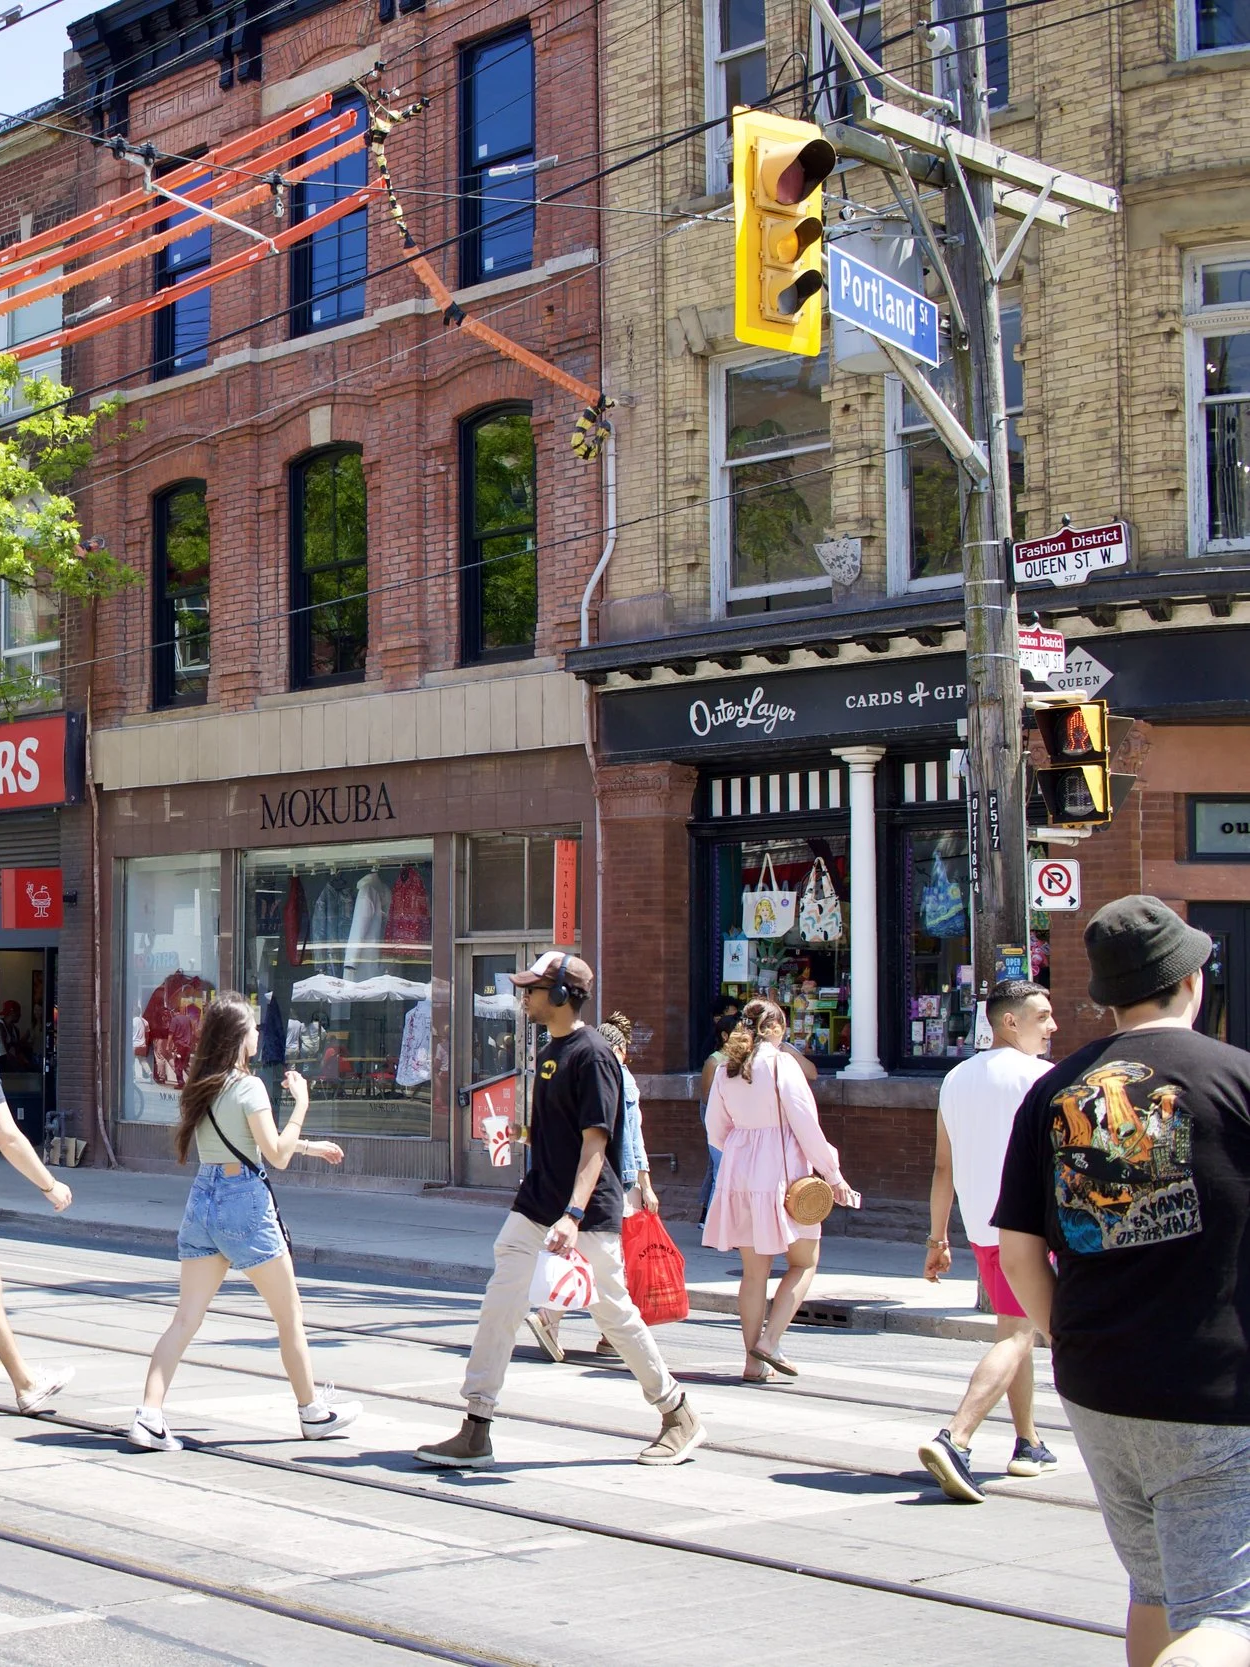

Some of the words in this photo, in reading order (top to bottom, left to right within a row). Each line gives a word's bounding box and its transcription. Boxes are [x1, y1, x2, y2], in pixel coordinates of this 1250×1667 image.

[840, 258, 916, 337] Portland
[919, 302, 929, 326] St
[1019, 541, 1066, 559] Fashion
[1071, 530, 1119, 549] District
[1024, 556, 1067, 579] QUEEN
[1074, 551, 1093, 570] ST.
[1100, 547, 1114, 565] W.
[1064, 574, 1077, 583] 577
[1018, 635, 1039, 647] ashion
[1040, 636, 1062, 648] District
[1065, 660, 1093, 674] 577
[1057, 675, 1100, 690] QUEEN
[845, 690, 903, 709] CARDS
[933, 684, 967, 700] GIF
[689, 698, 743, 737] Outer
[736, 686, 796, 734] Layer
[259, 781, 397, 831] MOKUBA
[561, 870, 569, 940] TAILORS
[1005, 957, 1021, 967] OPEN
[477, 1105, 509, 1113] THRD
[1140, 1187, 1198, 1221] VANS
